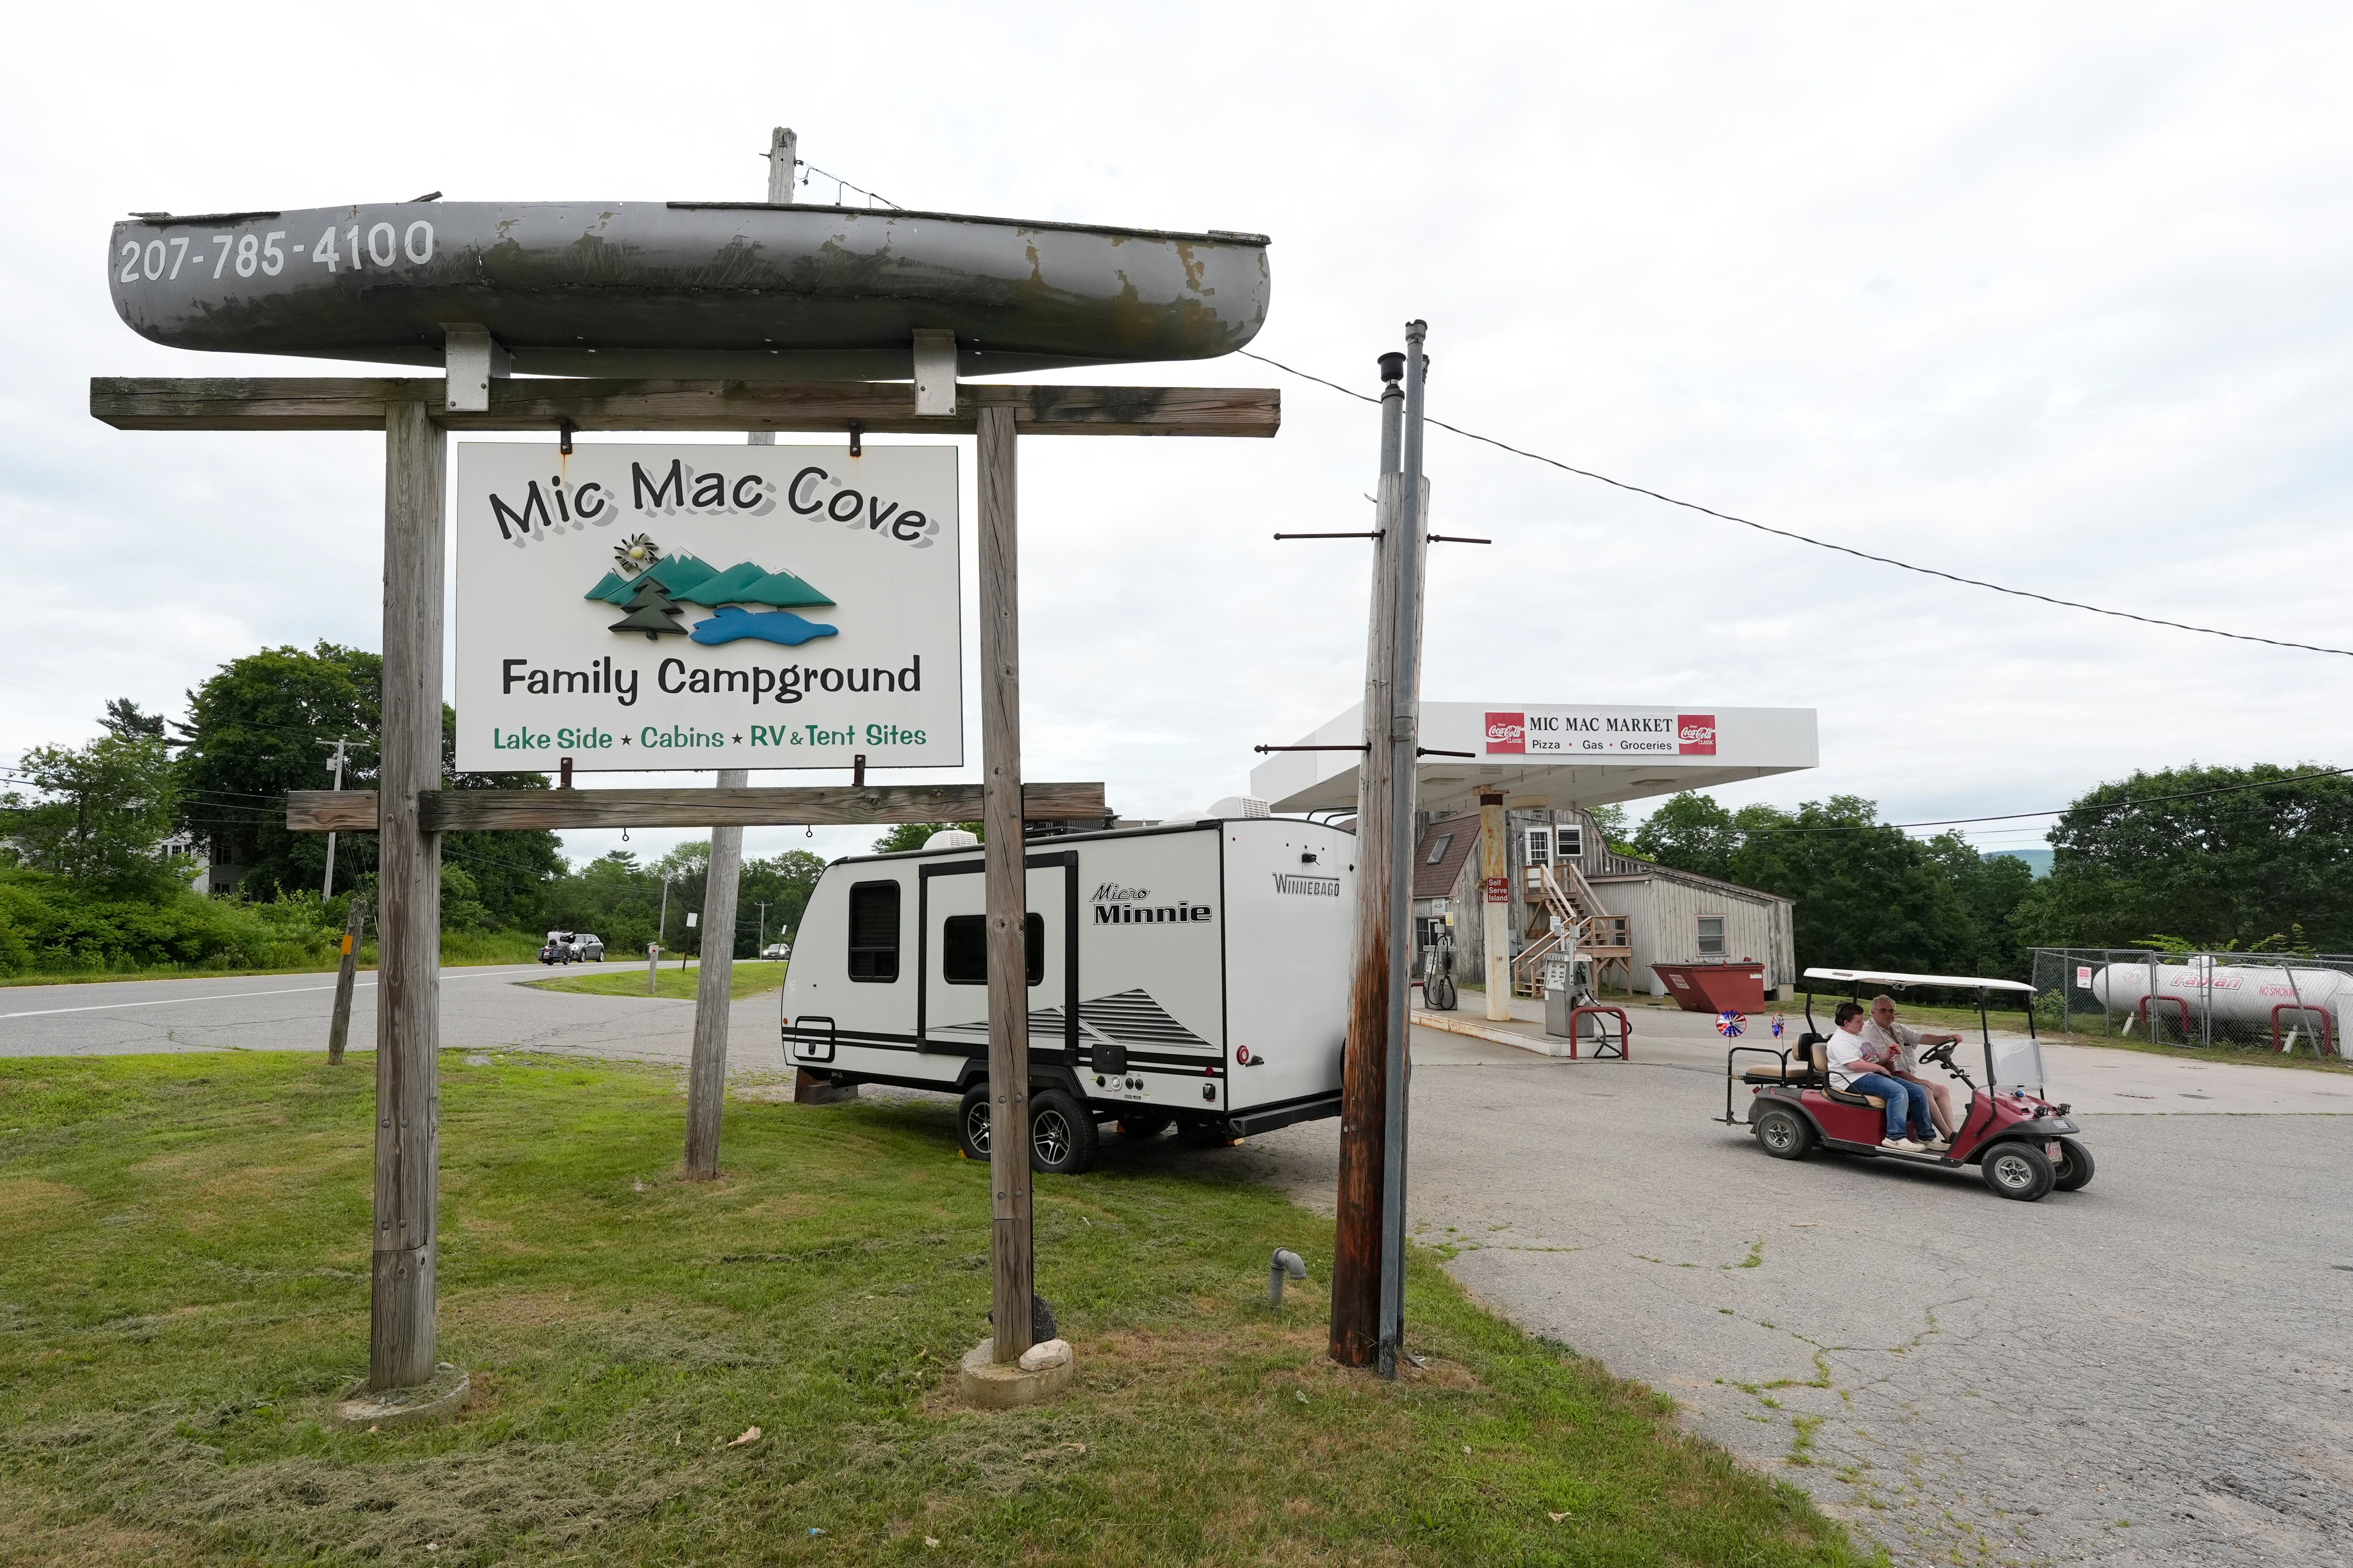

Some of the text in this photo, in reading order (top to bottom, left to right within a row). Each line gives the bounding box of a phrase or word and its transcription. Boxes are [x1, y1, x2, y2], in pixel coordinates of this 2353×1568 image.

[120, 219, 435, 284] 207-785-4100
[489, 459, 927, 541] Mic Mac Cove
[503, 655, 920, 706] Family Campground
[1489, 726, 1522, 737] Coca-Cola
[1530, 717, 1673, 732] MIC MAC MARKET
[1681, 727, 1713, 739] Coca-Cola
[494, 728, 550, 749] Lake
[557, 727, 612, 748] Side
[641, 725, 724, 748] Cabins
[751, 725, 786, 746] RV
[805, 725, 855, 745] Tent
[866, 724, 926, 746] Sites
[1532, 740, 1672, 750] Pizza Gas Groceries
[1089, 883, 1150, 902] Micro
[1093, 901, 1212, 925] Minnie
[2259, 986, 2269, 995] NO
